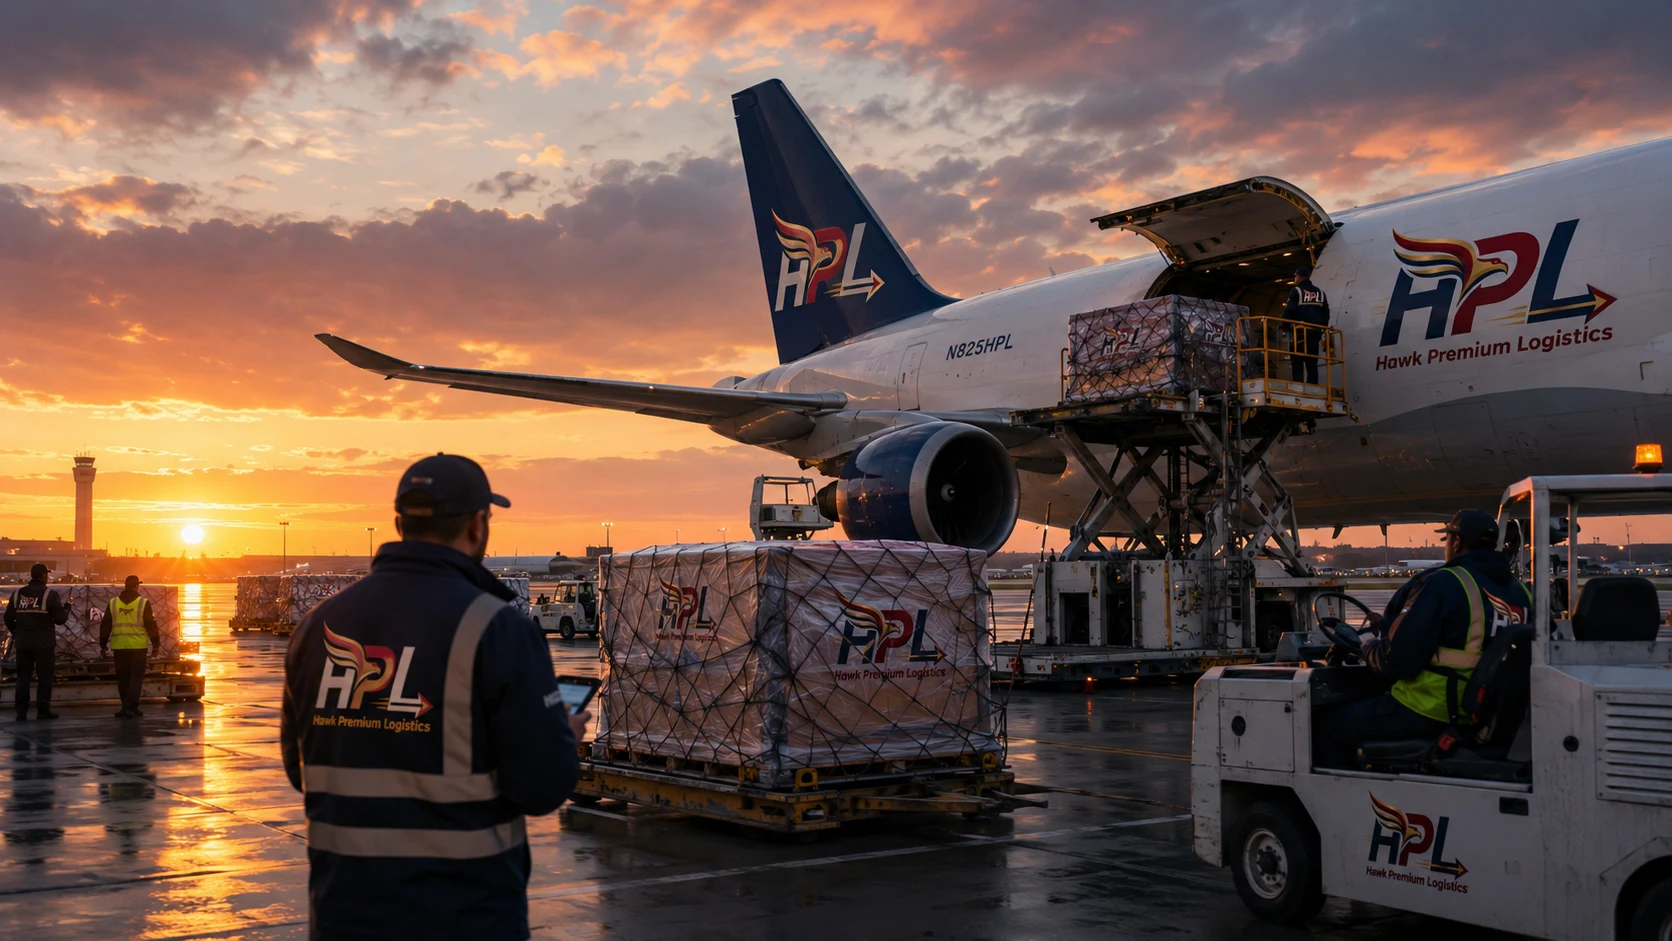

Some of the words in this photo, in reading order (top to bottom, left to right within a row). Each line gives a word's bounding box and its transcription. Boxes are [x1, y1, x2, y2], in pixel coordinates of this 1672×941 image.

[774, 222, 876, 312] HPL
[1380, 218, 1606, 347] HPL
[945, 333, 1013, 361] N825HPL
[1375, 350, 1422, 371] Hawk
[1427, 341, 1511, 365] Premium
[1517, 325, 1613, 353] Logistics
[658, 586, 714, 629] HPL
[837, 608, 941, 665] HPL
[315, 645, 424, 713] HPL
[338, 715, 381, 729] Premium
[384, 718, 431, 733] Logistics
[1368, 812, 1463, 876] HPL
[1366, 866, 1388, 879] Hawk
[1388, 871, 1425, 886] Premium
[1427, 876, 1468, 894] Logistics
